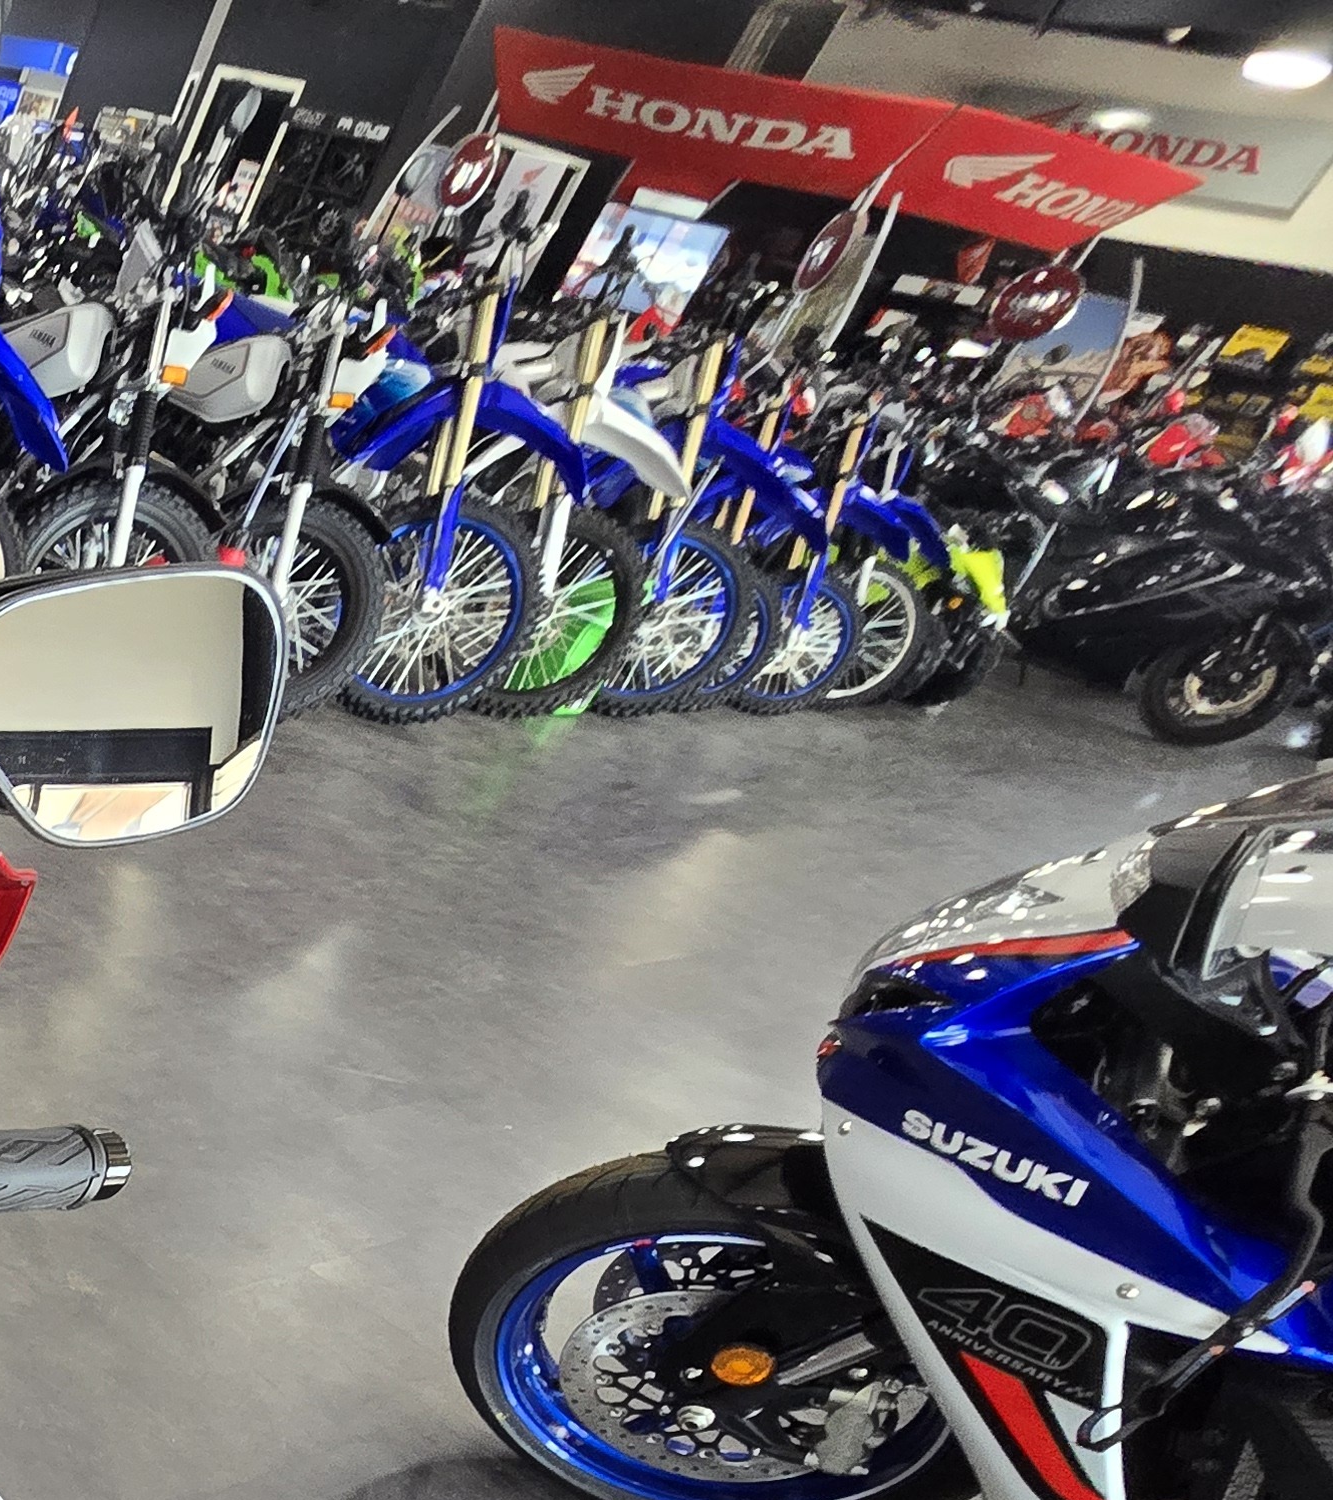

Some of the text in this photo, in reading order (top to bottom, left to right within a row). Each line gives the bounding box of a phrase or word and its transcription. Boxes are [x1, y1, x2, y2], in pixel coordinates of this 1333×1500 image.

[584, 84, 856, 160] HONDA
[1069, 122, 1261, 175] ONDA
[31, 329, 57, 348] YAMAHA
[210, 357, 237, 374] YAMAHA
[900, 1108, 1090, 1208] SUZUKI
[917, 1287, 1093, 1370] 40
[926, 1319, 1068, 1391] ANNIVERSARY
